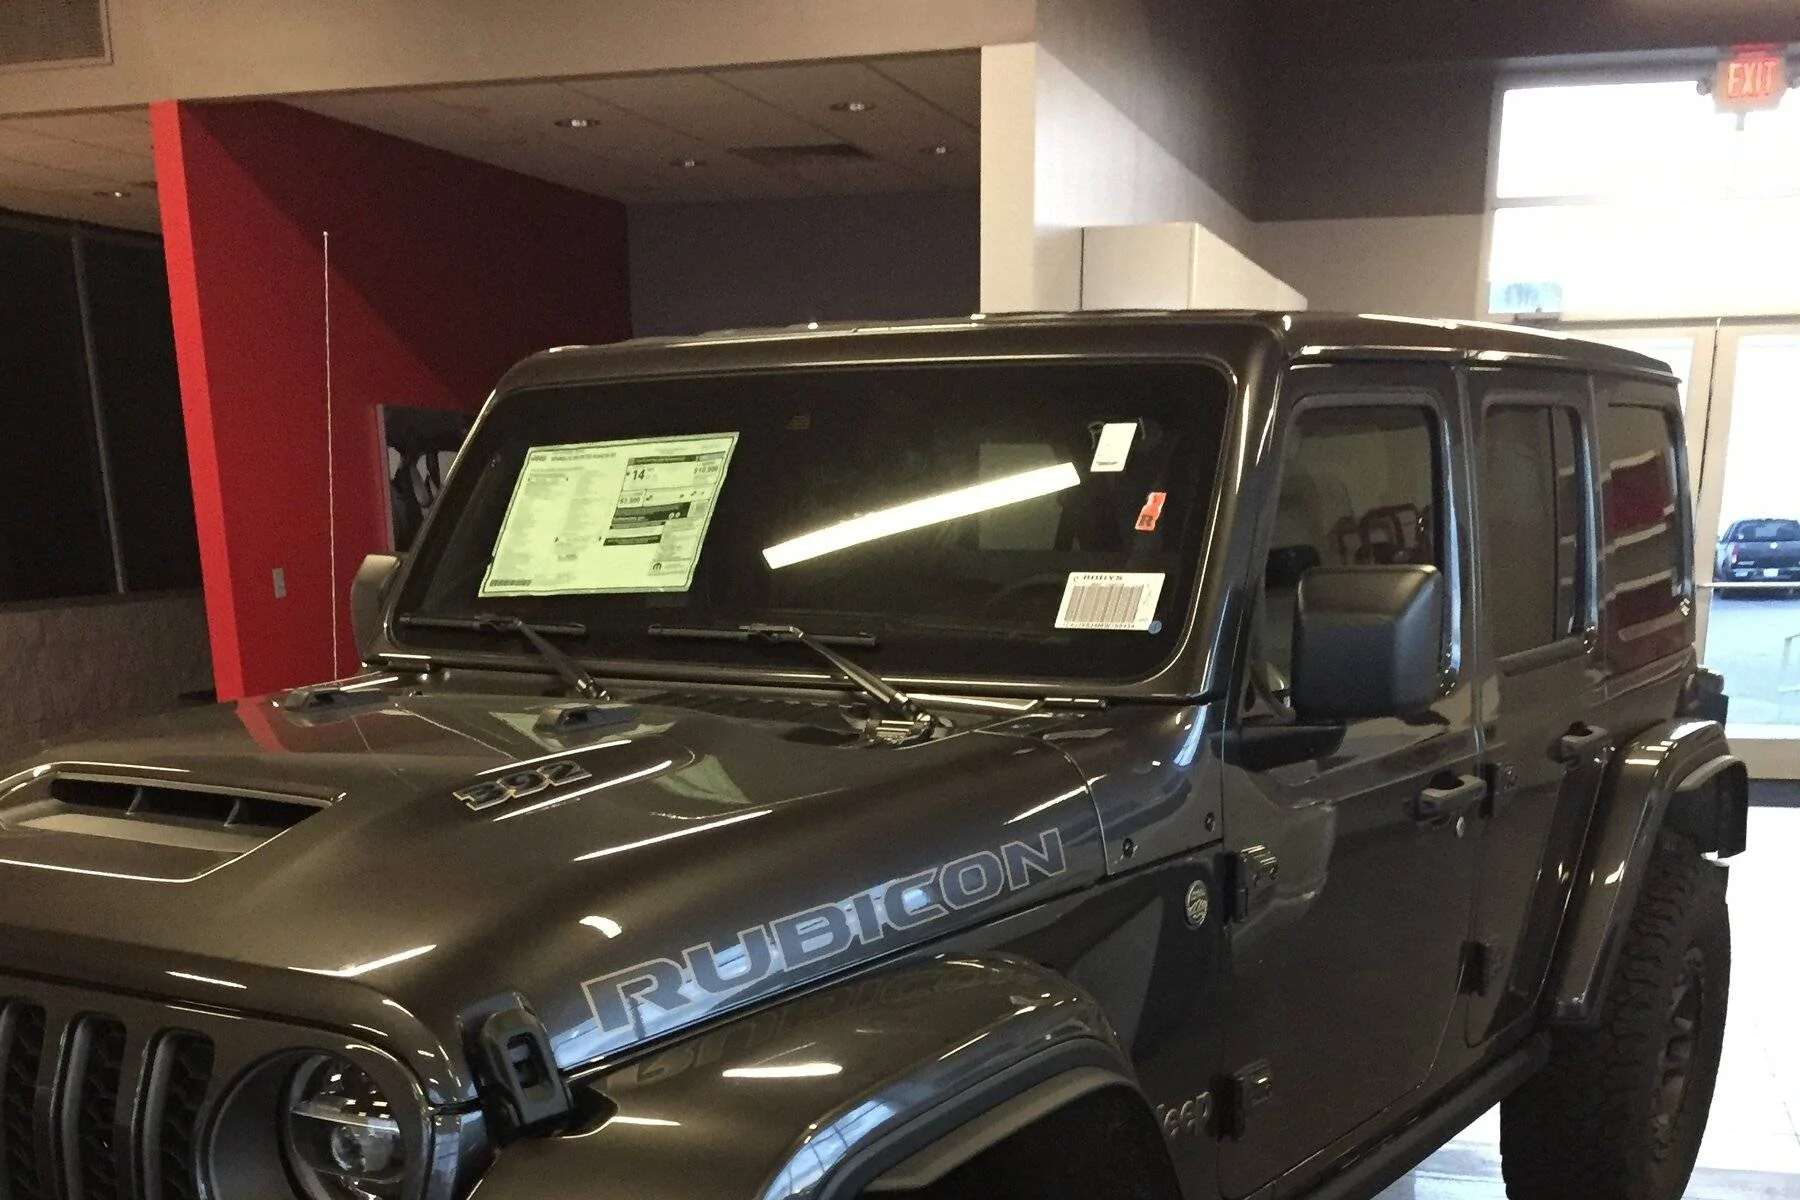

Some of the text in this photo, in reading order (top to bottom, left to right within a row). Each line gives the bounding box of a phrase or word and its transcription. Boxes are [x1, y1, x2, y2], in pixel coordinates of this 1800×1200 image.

[1727, 61, 1777, 97] EXIT
[632, 469, 646, 481] 14
[452, 760, 593, 812] 392
[580, 828, 1066, 1036] RUBICON
